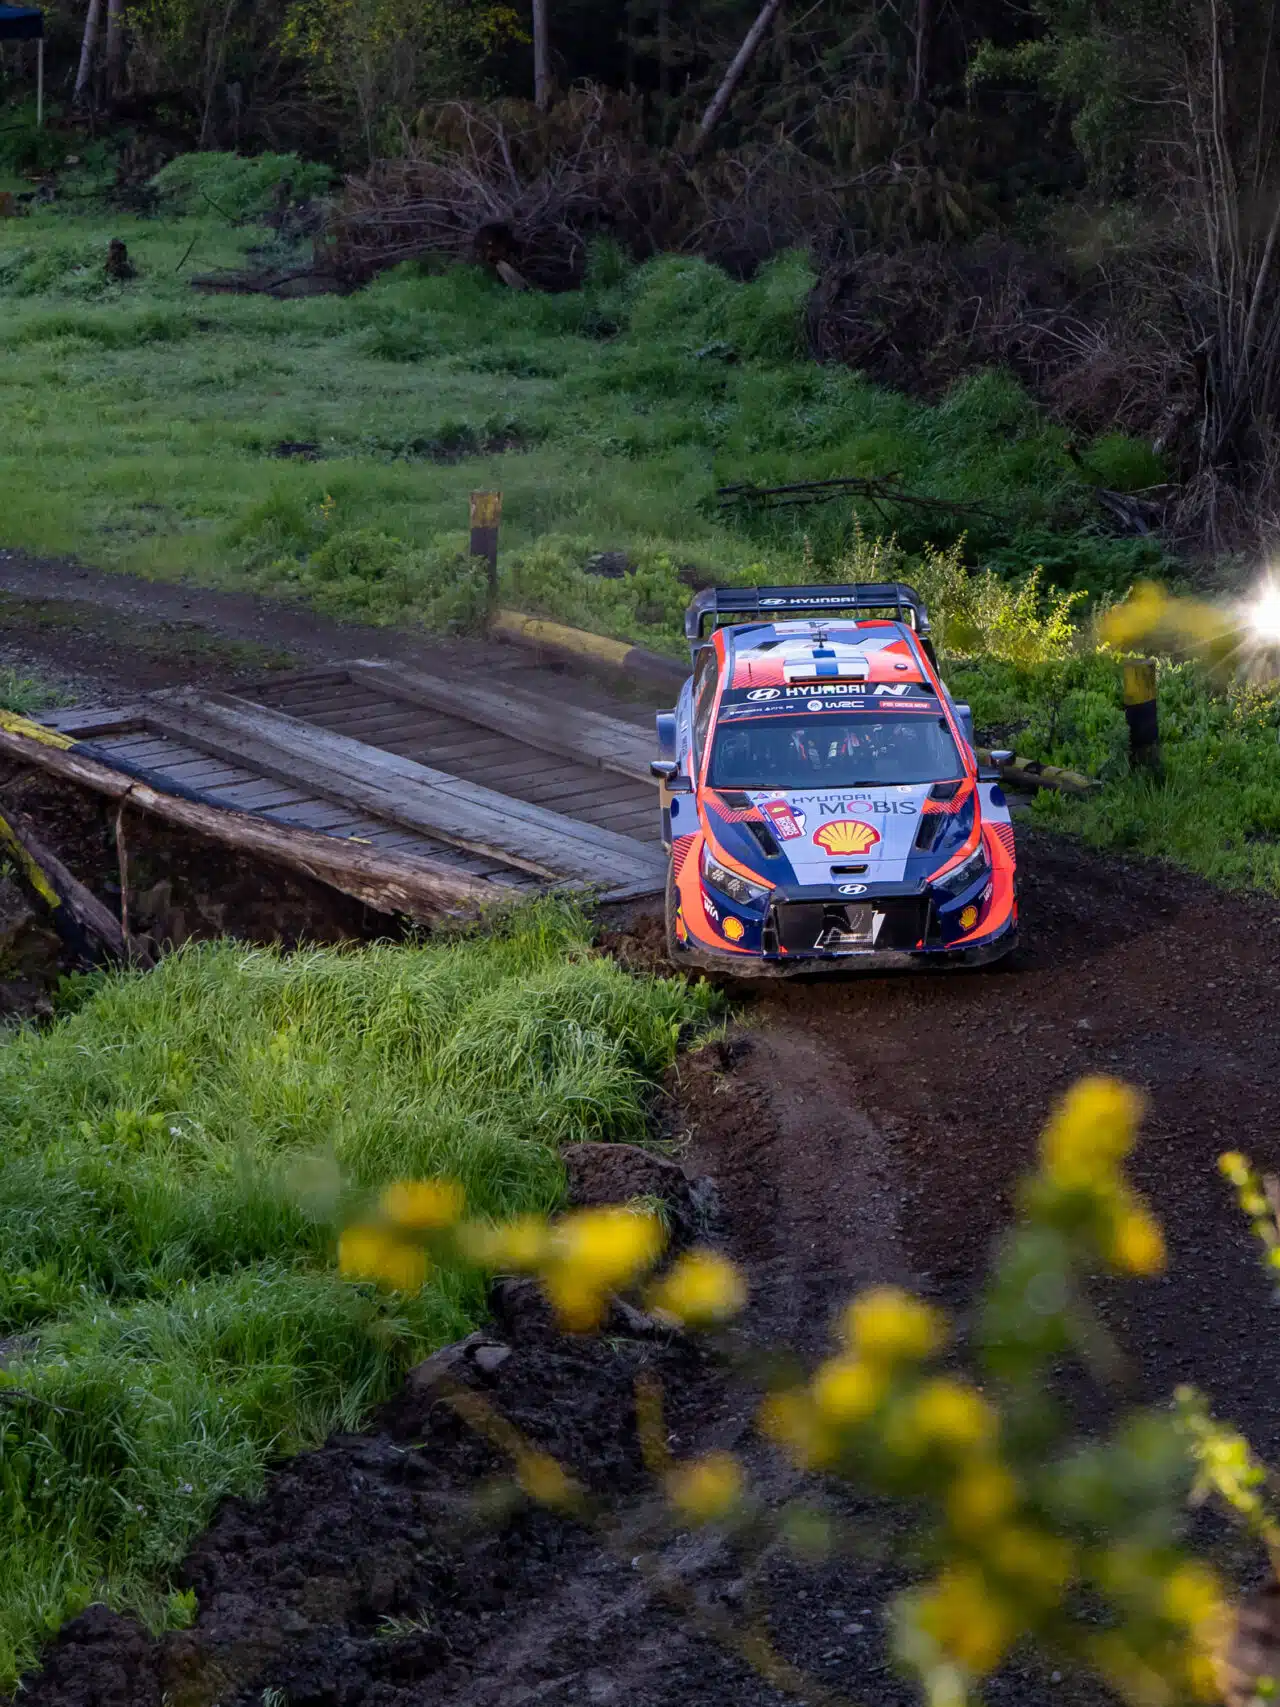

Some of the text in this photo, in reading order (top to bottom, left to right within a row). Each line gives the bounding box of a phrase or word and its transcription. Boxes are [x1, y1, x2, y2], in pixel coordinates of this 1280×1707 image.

[789, 596, 856, 604] HYUNDAI
[785, 684, 911, 697] HYUNDAI N
[792, 794, 872, 805] HYUNDAI
[819, 800, 918, 816] MOBIS
